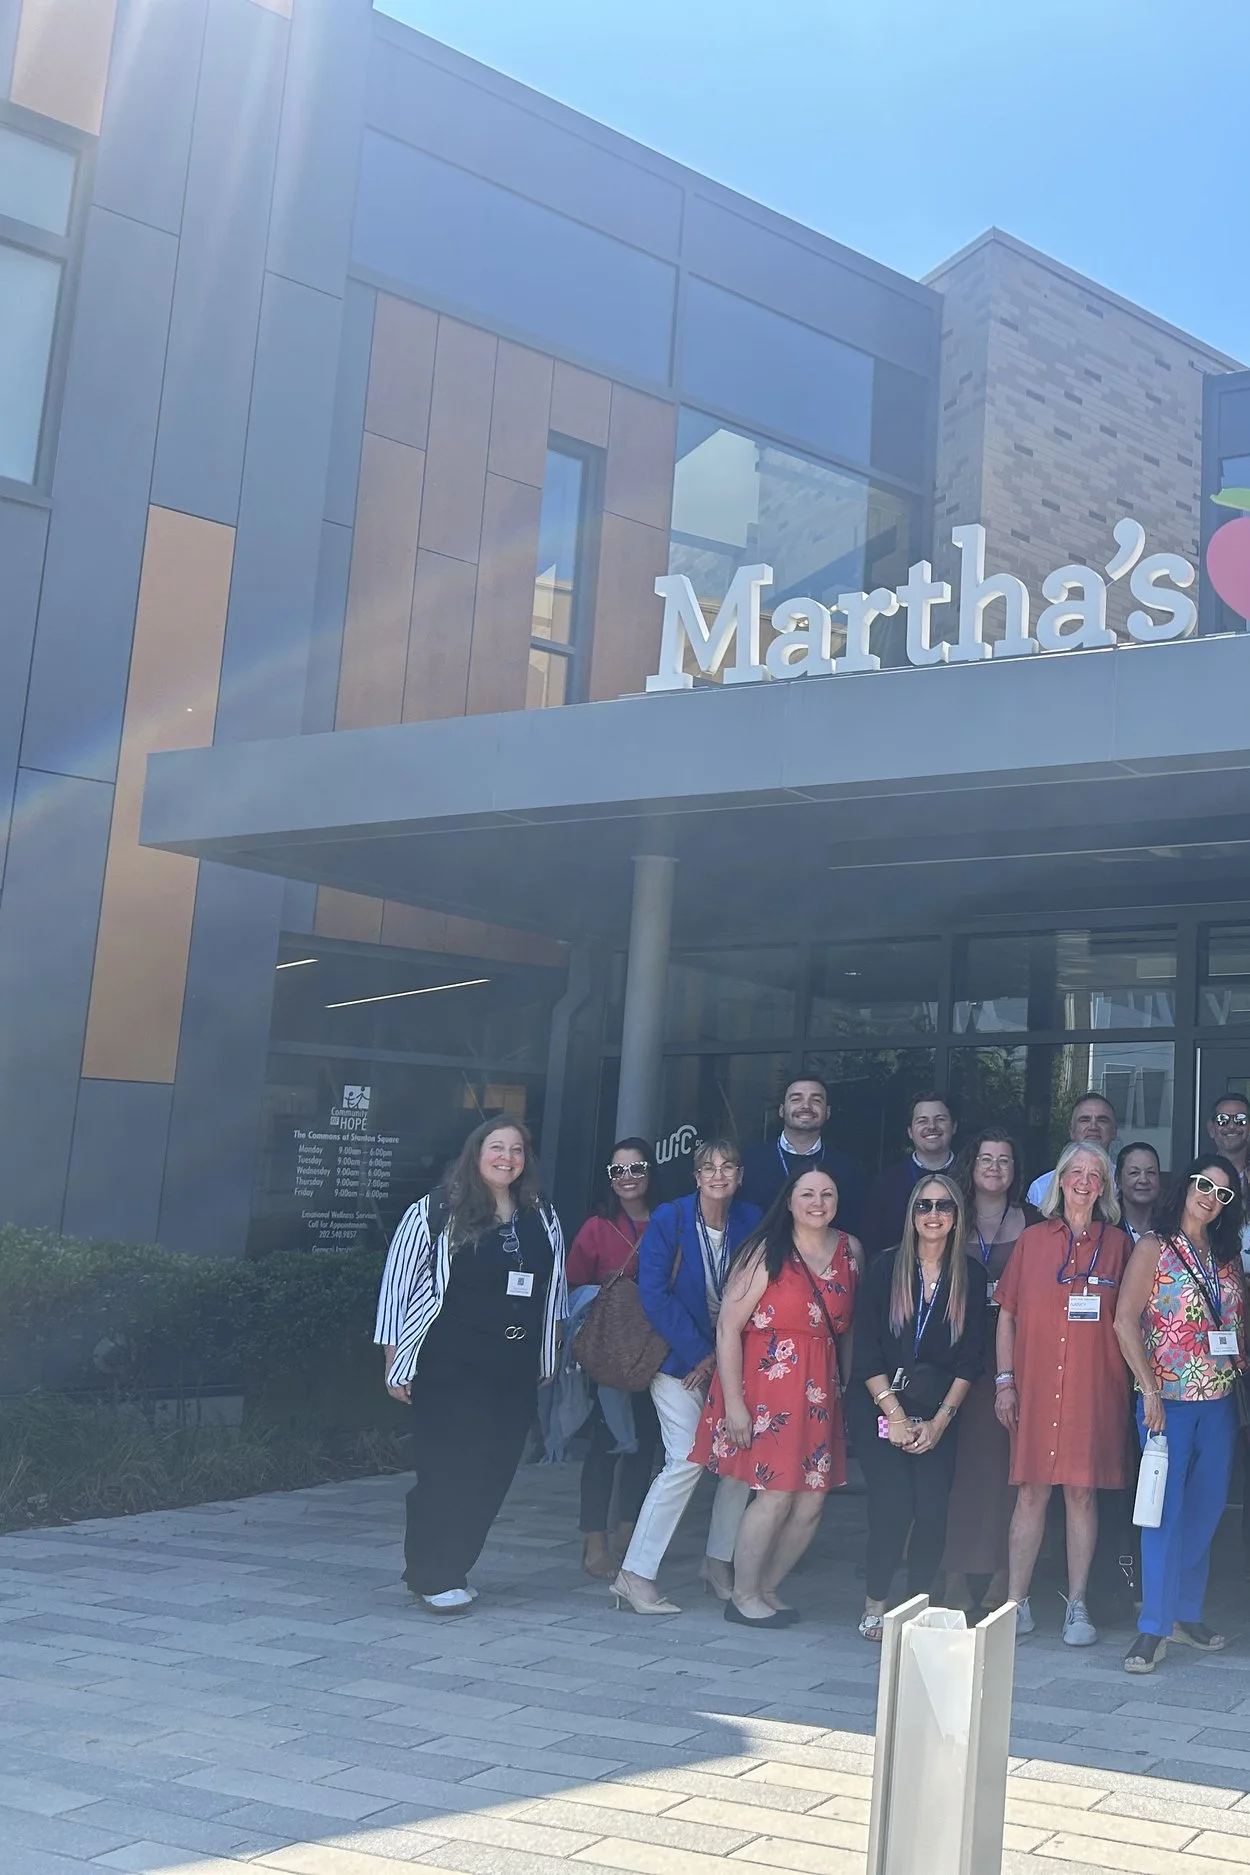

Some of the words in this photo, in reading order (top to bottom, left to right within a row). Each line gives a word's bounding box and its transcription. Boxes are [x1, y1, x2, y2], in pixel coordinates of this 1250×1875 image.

[646, 517, 1197, 693] Martha's
[331, 1106, 368, 1118] Community
[340, 1117, 368, 1130] HOPE
[293, 1130, 306, 1139] The
[308, 1131, 340, 1141] Commons
[342, 1133, 350, 1141] at
[351, 1133, 376, 1143] Stanton
[377, 1134, 400, 1144] Square
[298, 1144, 323, 1155] Monday
[298, 1155, 322, 1166] Tuesday
[297, 1166, 331, 1177] Wednesday
[296, 1176, 324, 1188] Thursday
[294, 1187, 313, 1198] Friday
